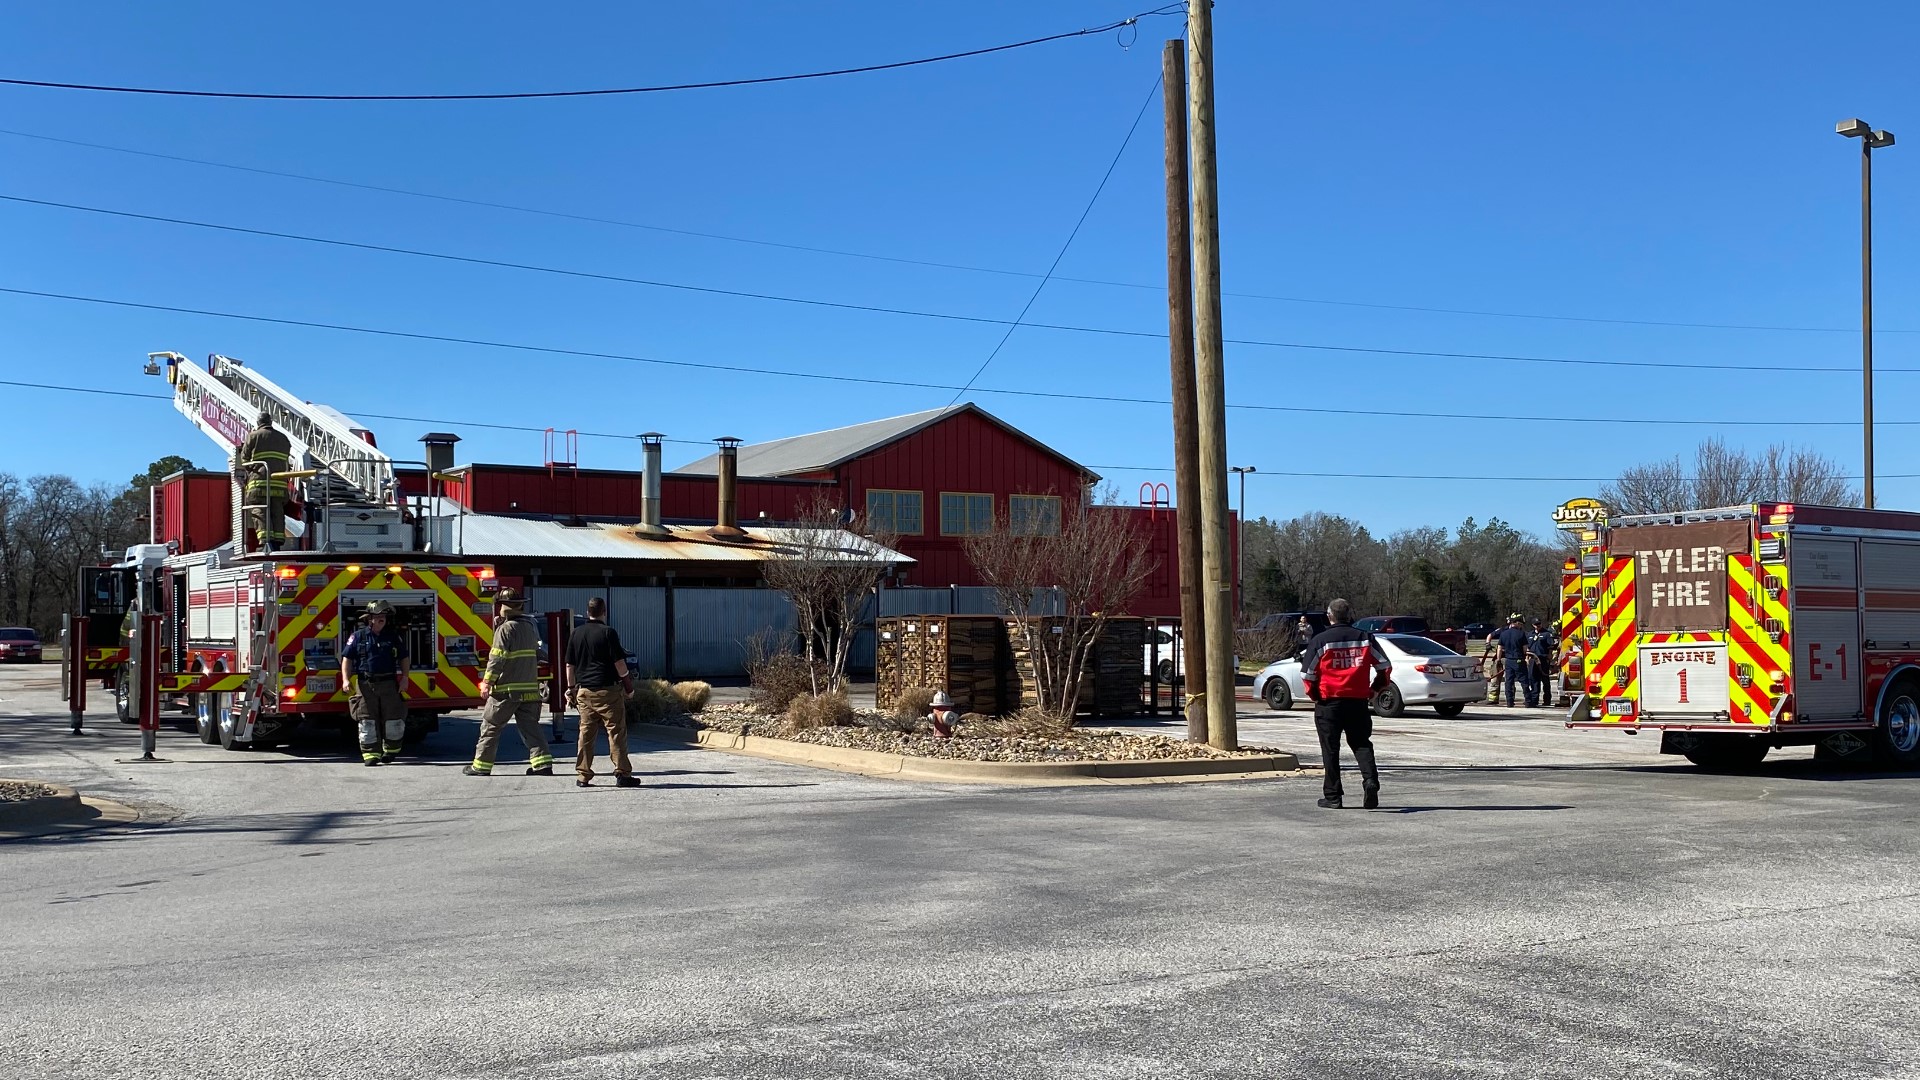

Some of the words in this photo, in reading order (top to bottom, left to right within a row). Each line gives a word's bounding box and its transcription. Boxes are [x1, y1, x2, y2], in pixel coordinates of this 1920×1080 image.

[1636, 546, 1725, 575] TYLER
[1652, 580, 1711, 607] FIRE
[1333, 649, 1363, 657] TYLER
[1333, 657, 1363, 668] FIRE
[1651, 651, 1717, 666] ENGINE
[1809, 643, 1847, 681] E-1
[1677, 668, 1690, 703] 1
